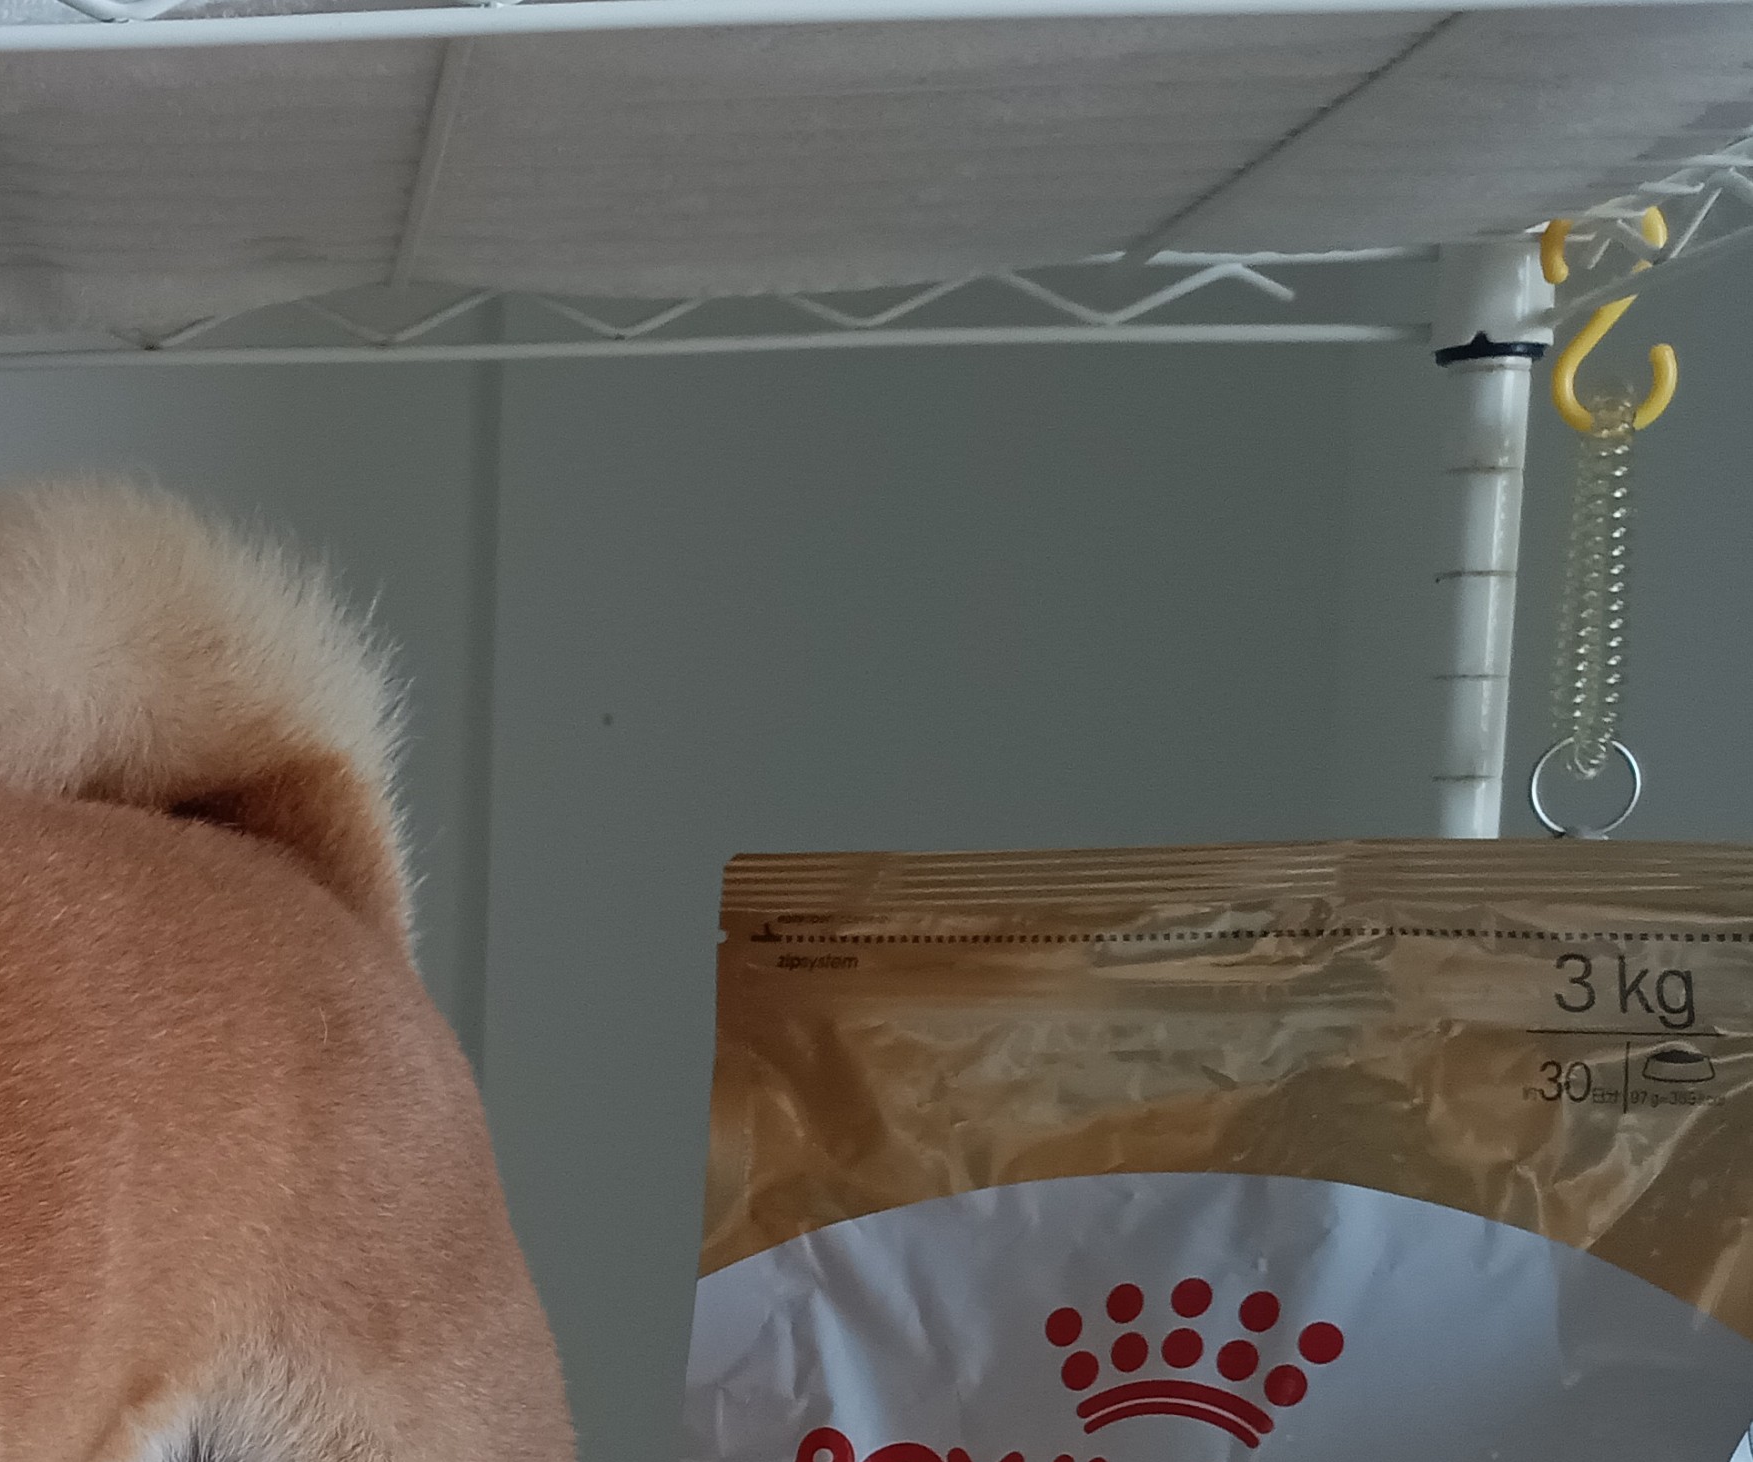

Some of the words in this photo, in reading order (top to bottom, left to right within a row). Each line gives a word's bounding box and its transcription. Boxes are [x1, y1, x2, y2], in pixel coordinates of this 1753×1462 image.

[1554, 953, 1596, 1013] 3
[1618, 955, 1695, 1030] kg
[1539, 1060, 1593, 1103] 30
